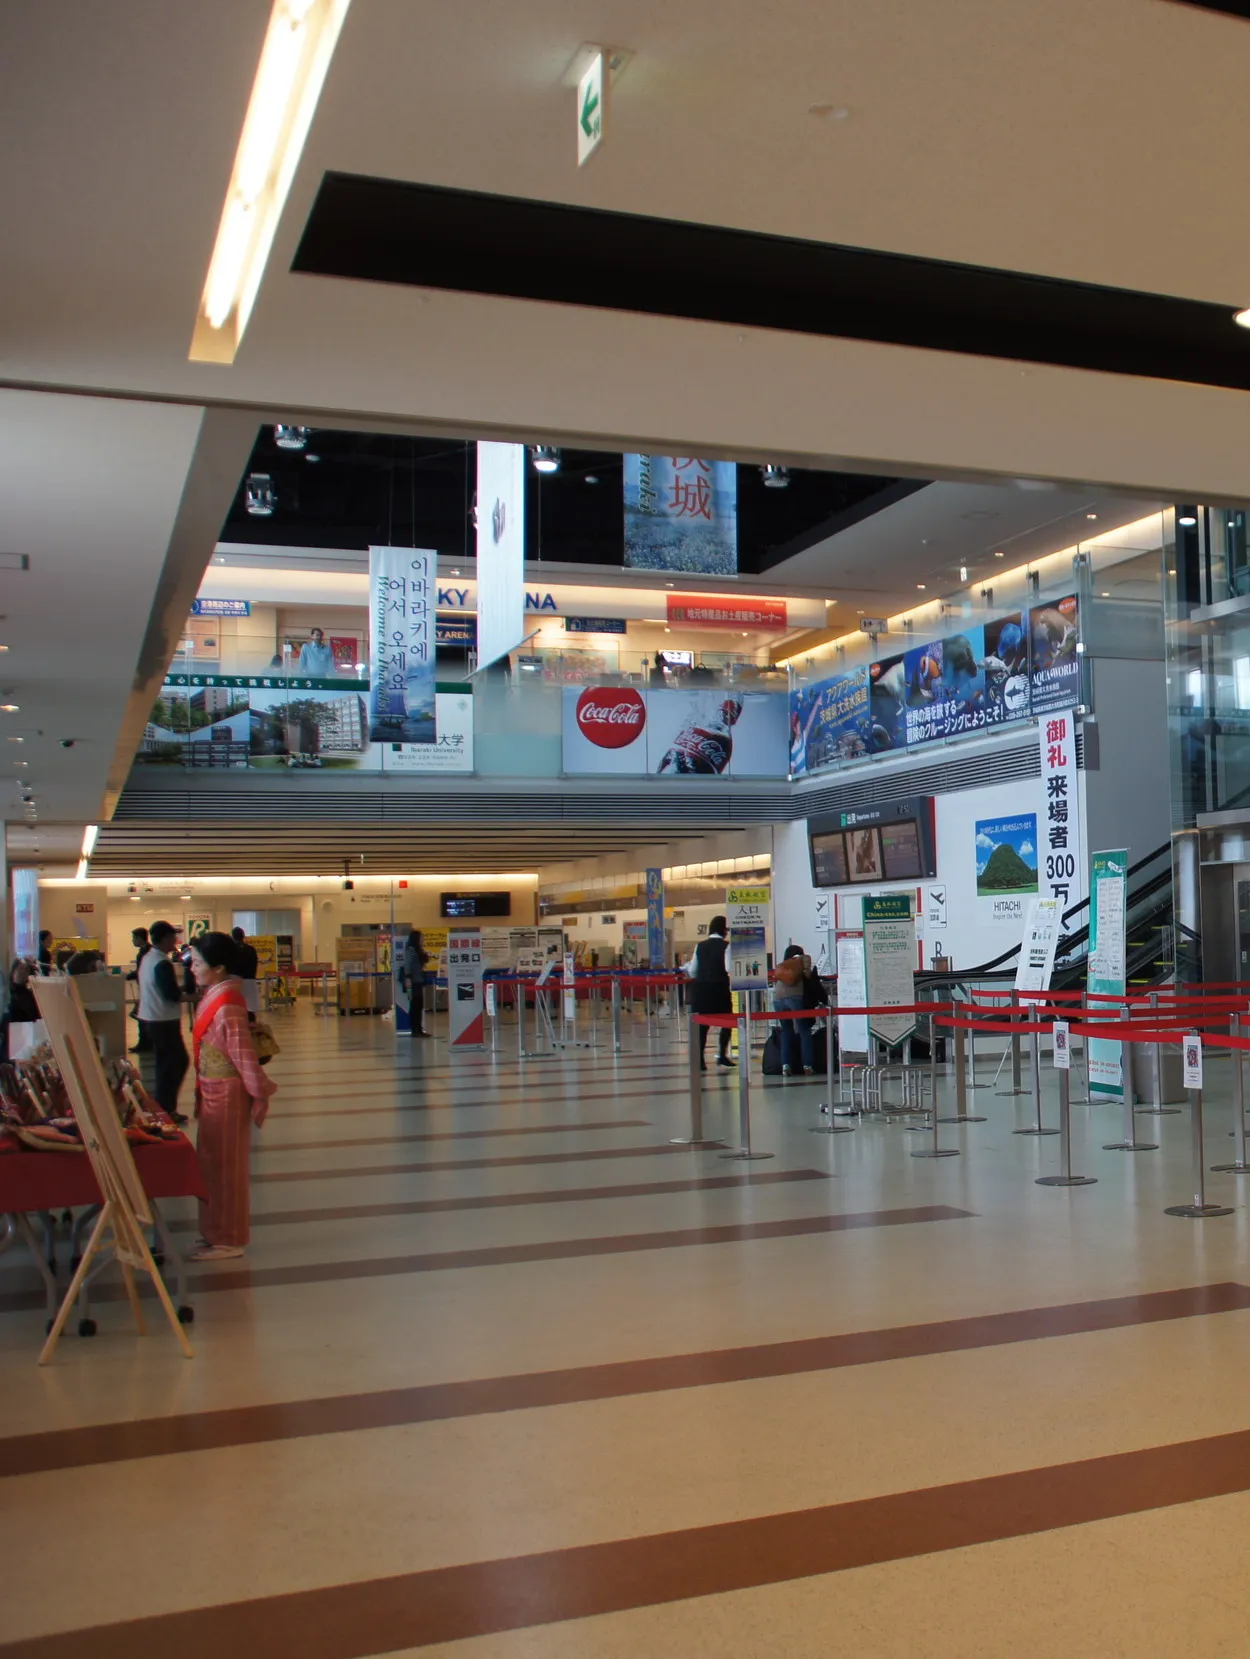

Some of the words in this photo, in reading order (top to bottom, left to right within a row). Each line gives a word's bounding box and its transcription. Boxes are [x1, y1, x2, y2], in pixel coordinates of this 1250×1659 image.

[377, 576, 389, 637] Welcome
[388, 576, 407, 618] 어서
[410, 556, 431, 663] 이바라키에
[377, 641, 389, 655] to
[388, 630, 409, 691] 오세요
[579, 701, 643, 725] Coca-Cola
[905, 700, 957, 727] 世界の海を旅する
[1046, 718, 1067, 768] 御礼
[993, 900, 1021, 911] HITACHI
